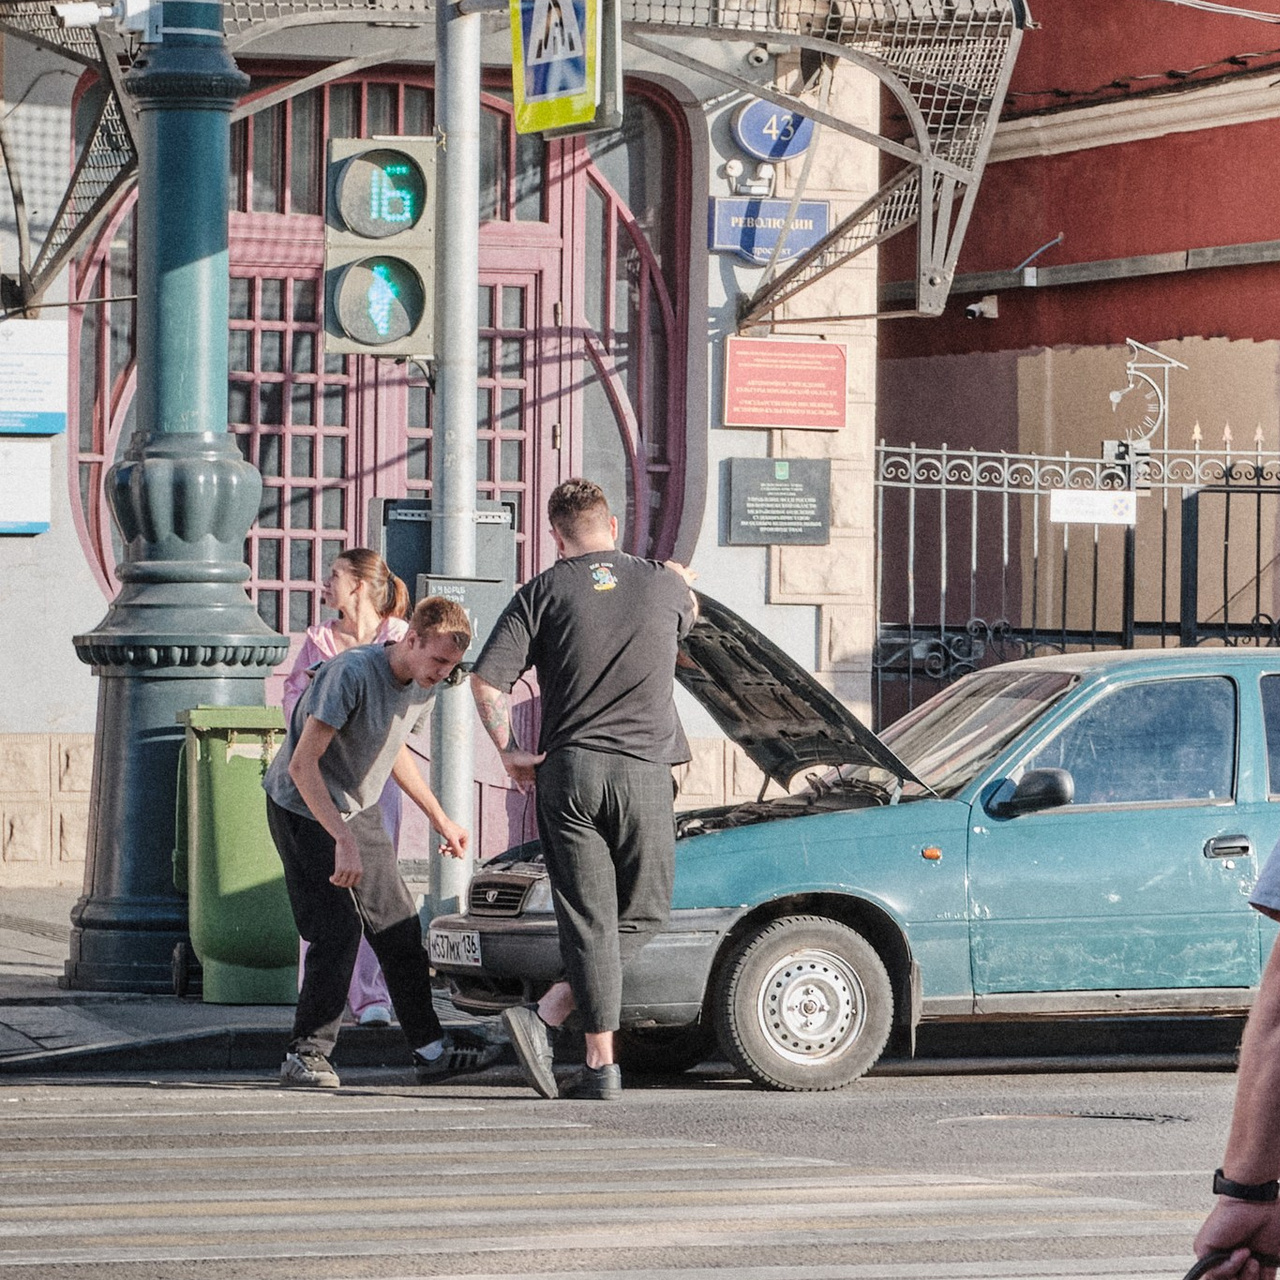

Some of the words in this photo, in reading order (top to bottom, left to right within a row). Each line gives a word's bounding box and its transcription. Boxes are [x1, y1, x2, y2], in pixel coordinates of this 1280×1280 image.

[762, 114, 795, 141] 43
[371, 165, 412, 222] 16
[752, 247, 792, 256] проскт
